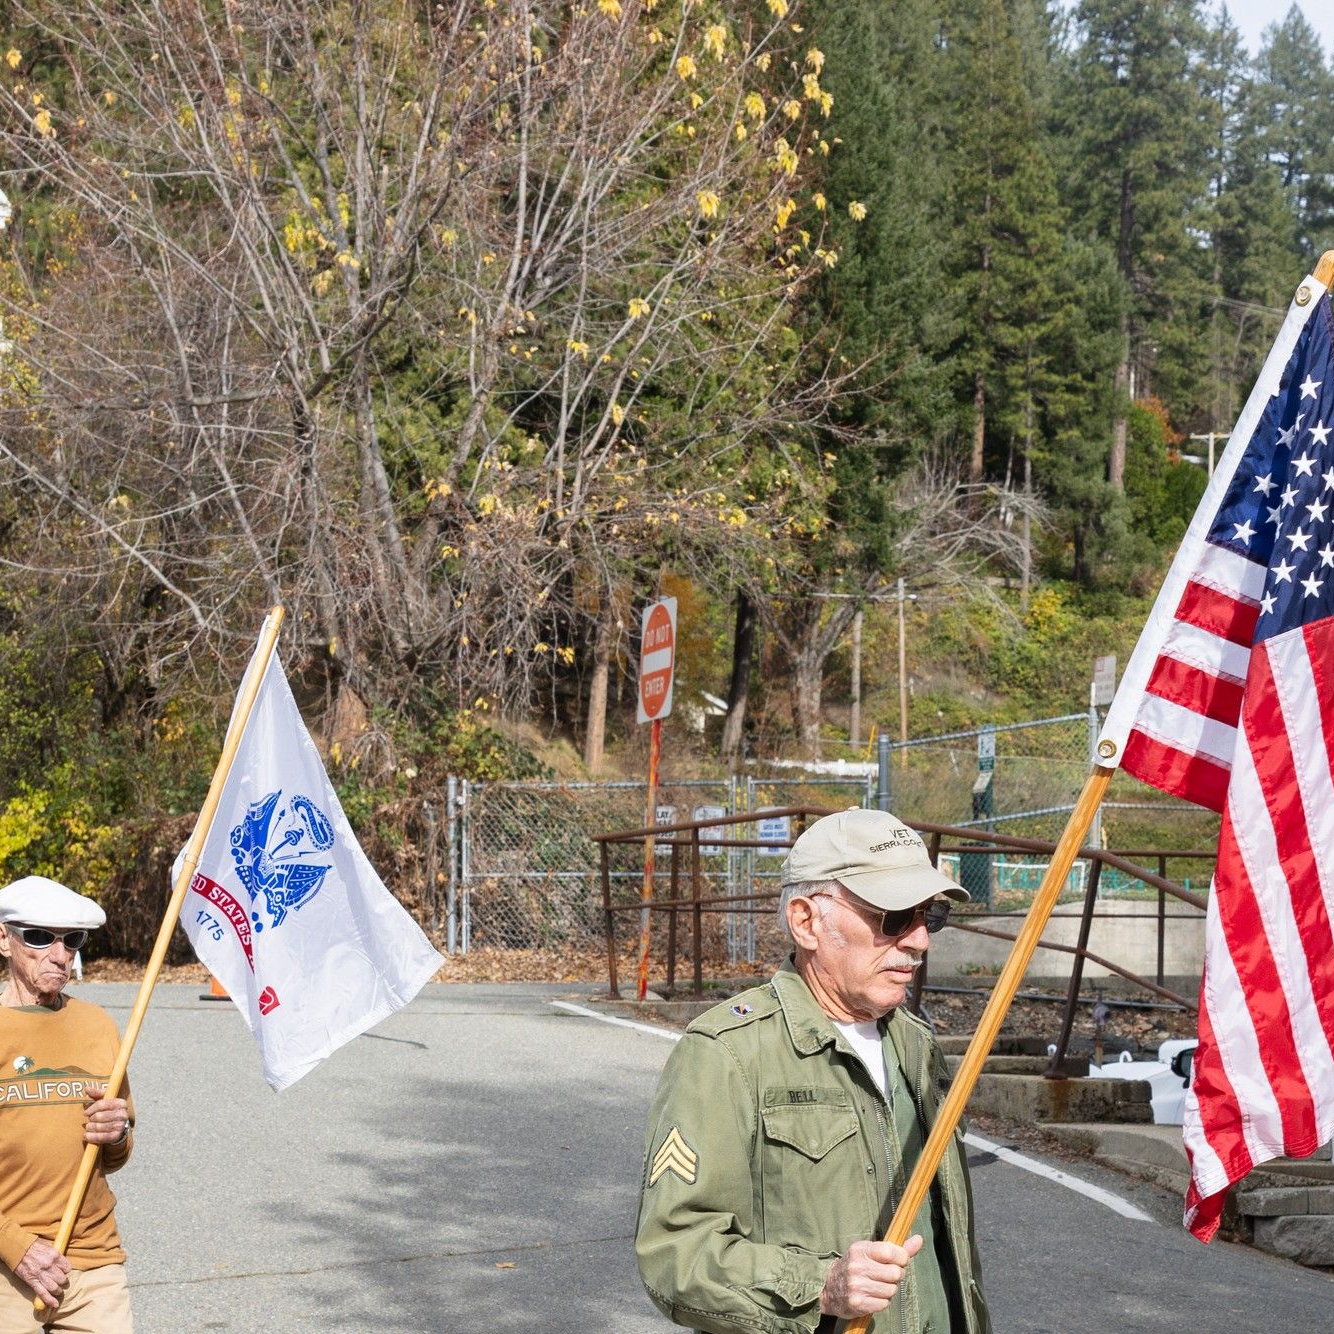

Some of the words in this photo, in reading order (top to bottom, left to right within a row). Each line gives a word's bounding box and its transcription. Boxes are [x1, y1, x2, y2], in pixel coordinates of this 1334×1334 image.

[645, 630, 655, 648] DO
[655, 623, 671, 645] NOT
[645, 676, 665, 699] ENTER
[656, 811, 668, 819] LAY
[889, 828, 911, 839] VET
[869, 840, 902, 853] SIERRA
[196, 910, 225, 941] 1775
[208, 887, 252, 946] STATES
[788, 1090, 817, 1104] BELL
